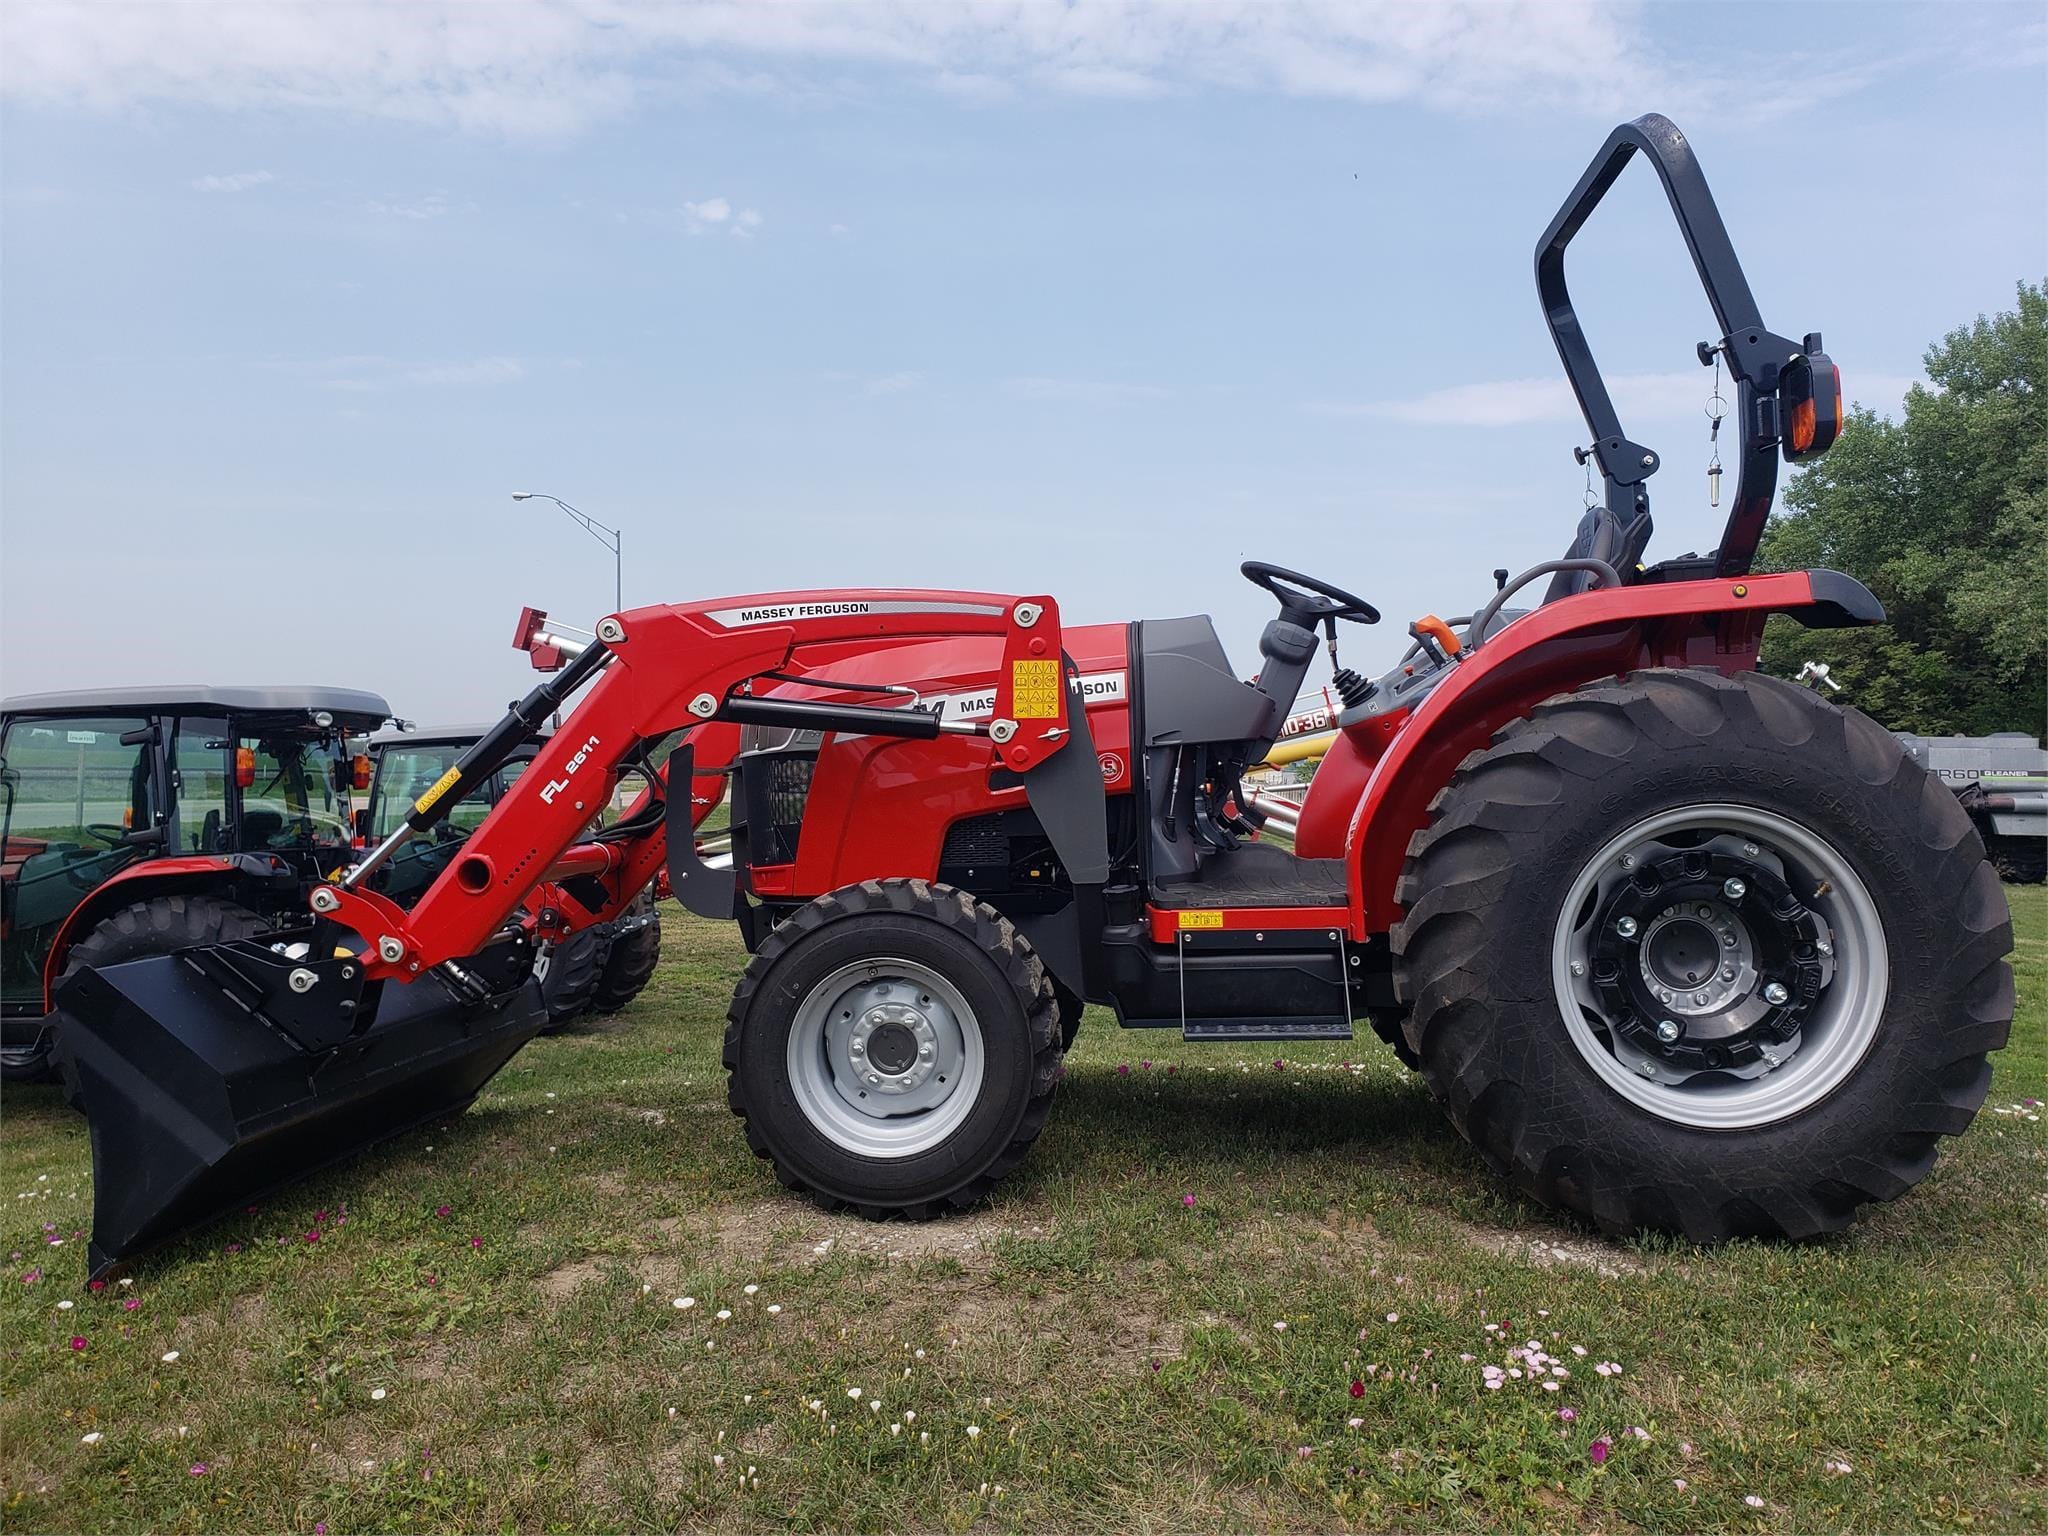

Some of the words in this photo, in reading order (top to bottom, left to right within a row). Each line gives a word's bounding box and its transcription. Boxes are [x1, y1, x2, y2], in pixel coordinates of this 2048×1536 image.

[741, 607, 795, 621] MASSEY
[799, 603, 869, 616] FERGUSON
[960, 697, 994, 712] MAS
[540, 779, 569, 804] FL
[565, 735, 600, 775] 2611
